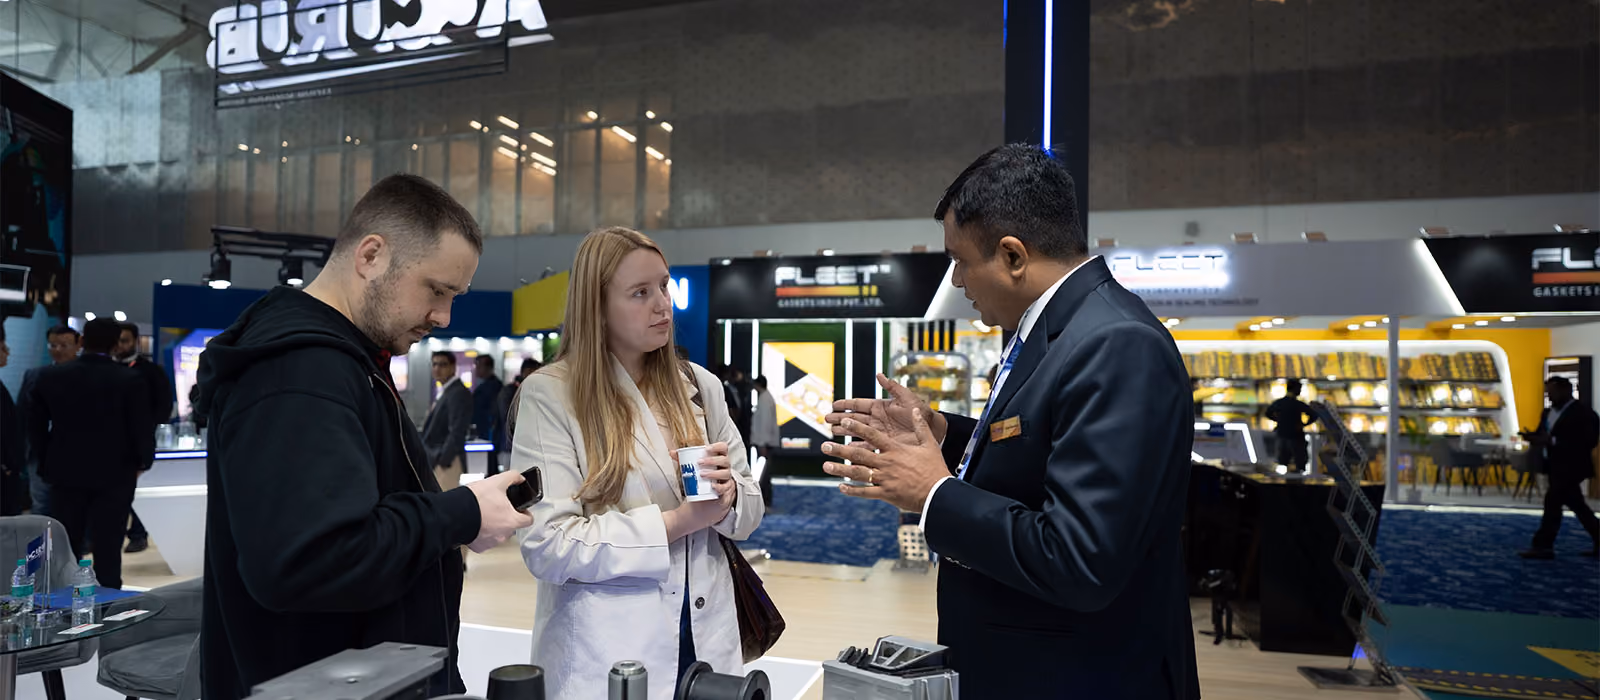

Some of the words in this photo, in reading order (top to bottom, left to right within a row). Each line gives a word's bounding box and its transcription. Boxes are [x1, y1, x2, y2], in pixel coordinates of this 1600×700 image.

[1112, 254, 1224, 271] FLEET
[1532, 247, 1600, 269] FL
[775, 265, 879, 286] FLEET
[1532, 286, 1592, 297] GASKETS
